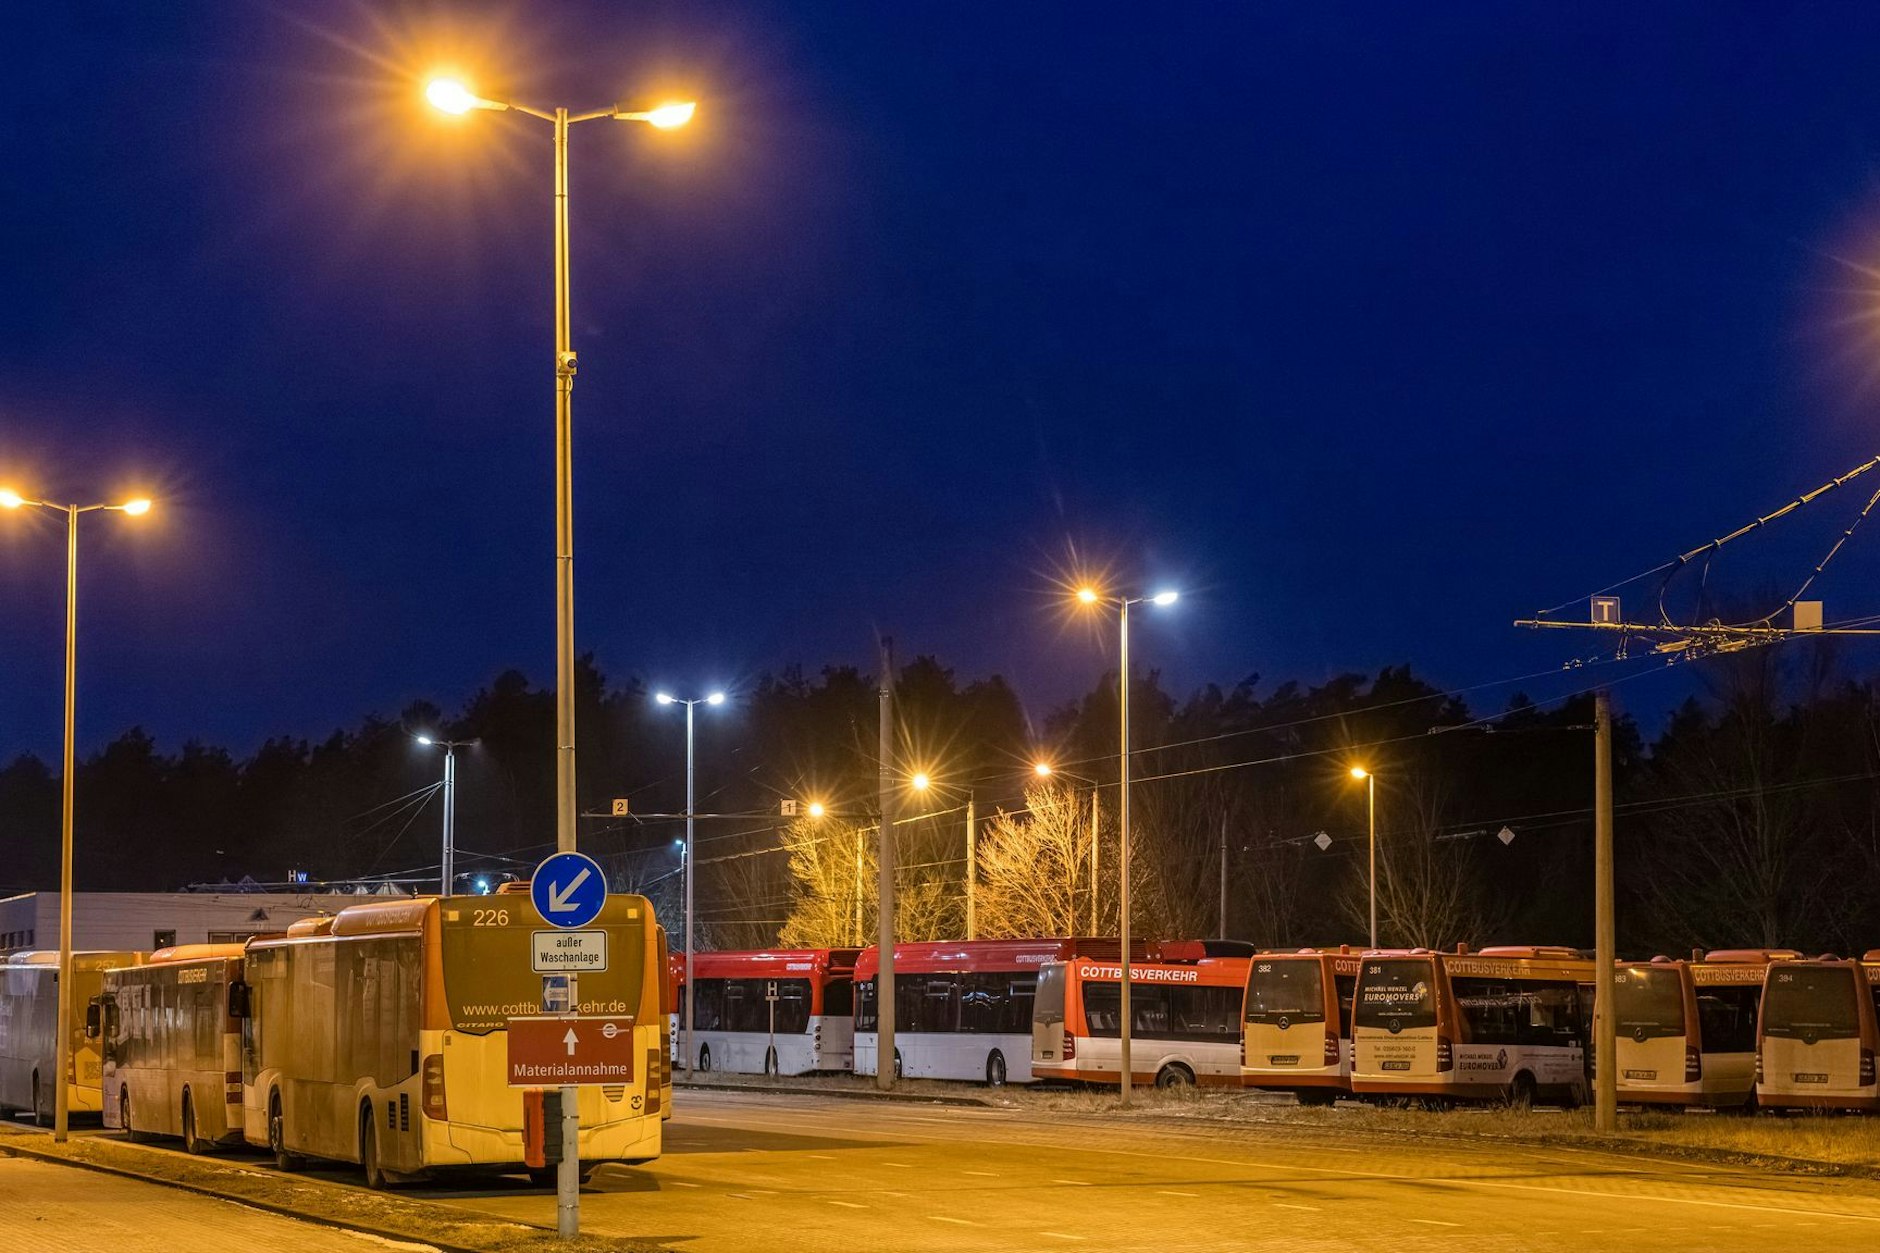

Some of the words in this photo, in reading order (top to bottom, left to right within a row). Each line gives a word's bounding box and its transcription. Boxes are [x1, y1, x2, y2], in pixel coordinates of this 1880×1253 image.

[1597, 601, 1614, 621] T
[473, 909, 509, 927] 226
[556, 936, 583, 948] außer
[540, 951, 600, 965] Waschanlage
[1080, 966, 1198, 982] COTTBSVERKEHR
[1258, 964, 1272, 973] 382
[767, 981, 778, 996] H
[1364, 993, 1420, 1001] EUROMOVERS
[462, 1000, 627, 1016] www.cottbukehr.de
[513, 1062, 628, 1077] Materialannahme
